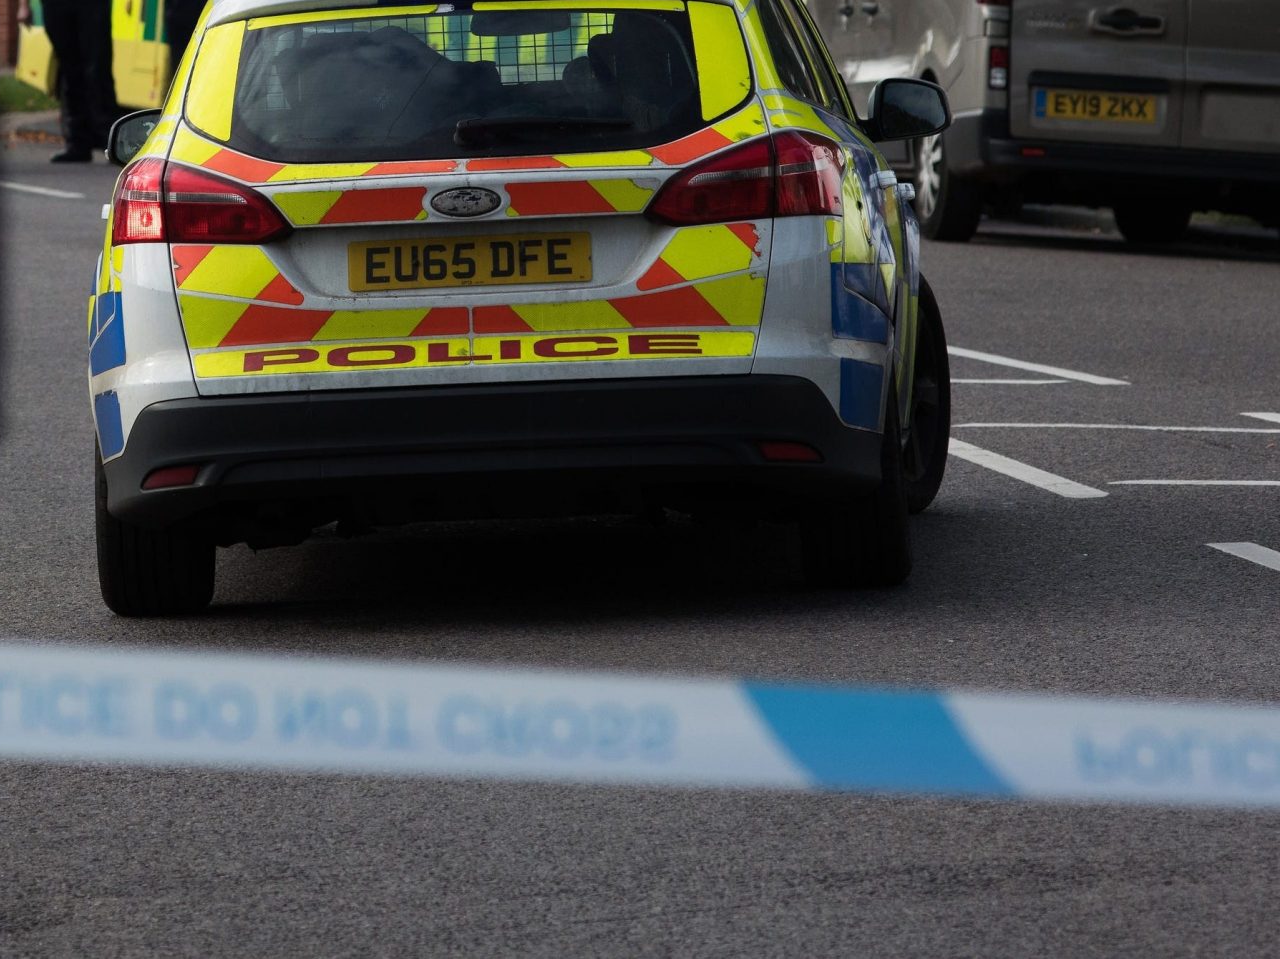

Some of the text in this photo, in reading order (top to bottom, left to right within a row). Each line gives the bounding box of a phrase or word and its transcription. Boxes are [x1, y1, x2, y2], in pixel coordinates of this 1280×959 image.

[1054, 93, 1149, 118] EY19 ZKX
[365, 239, 573, 284] EU65 DFE
[243, 334, 703, 372] POLICE
